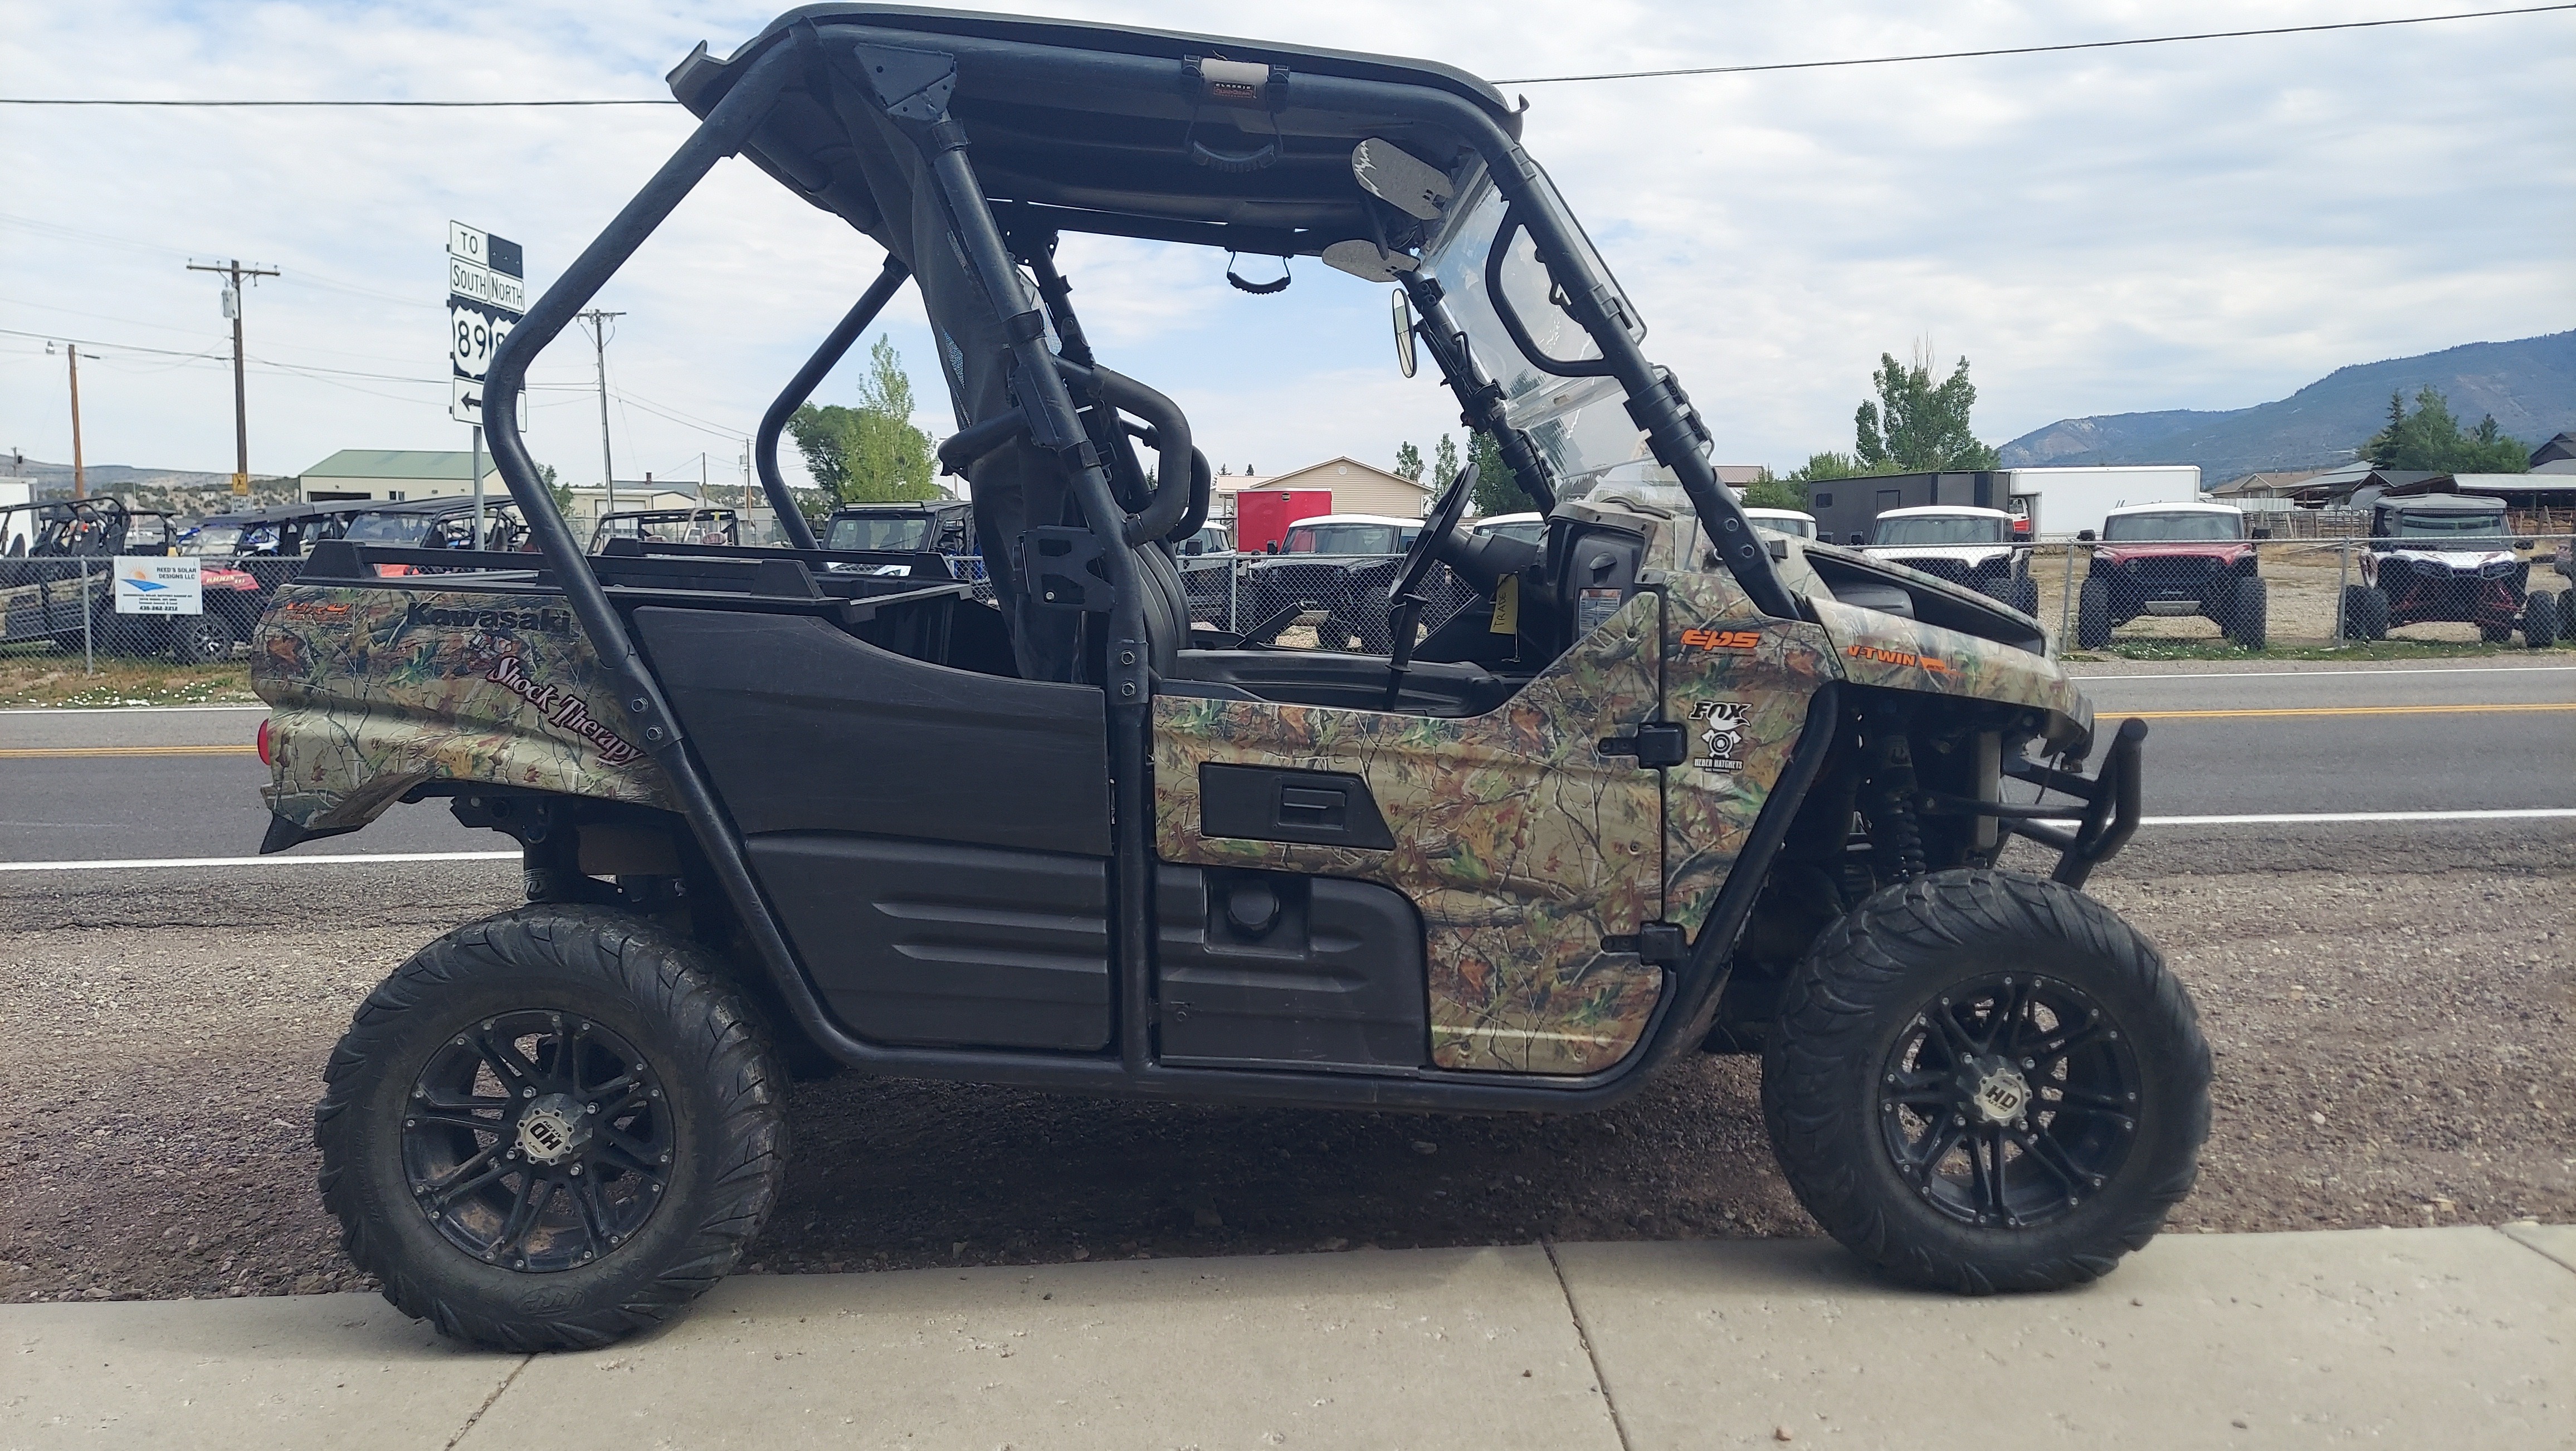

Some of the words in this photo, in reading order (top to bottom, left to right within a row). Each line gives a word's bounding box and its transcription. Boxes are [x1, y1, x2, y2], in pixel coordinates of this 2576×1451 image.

[461, 231, 478, 254] TO
[453, 265, 487, 296] SOUTH
[491, 276, 523, 307] NORTH
[458, 320, 487, 360] 89
[1493, 592, 1506, 628] TRADE
[1847, 645, 1916, 668] V-TWIN
[486, 656, 559, 713] Shock
[548, 694, 646, 767] Therapy
[1688, 700, 1754, 723] FOX
[1714, 759, 1743, 770] HATCHETS
[1985, 1085, 2018, 1109] HD
[530, 1122, 563, 1151] HD
